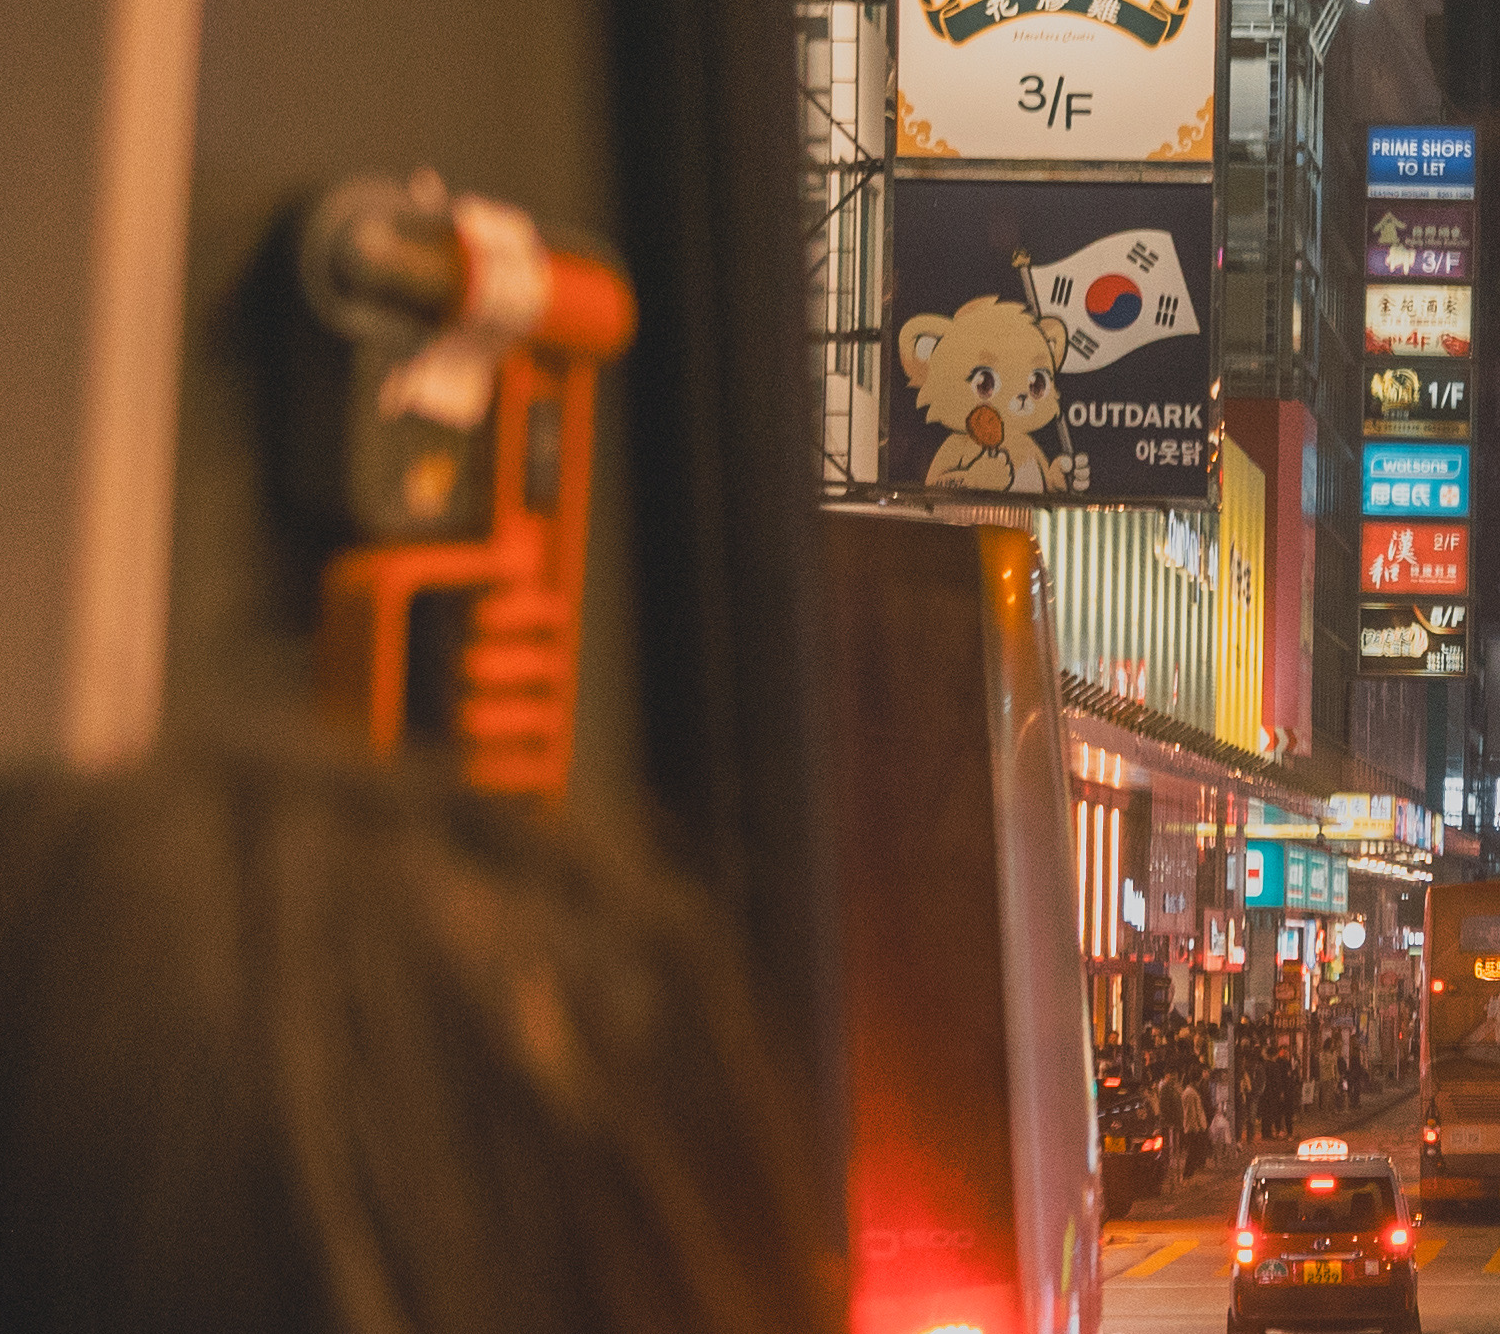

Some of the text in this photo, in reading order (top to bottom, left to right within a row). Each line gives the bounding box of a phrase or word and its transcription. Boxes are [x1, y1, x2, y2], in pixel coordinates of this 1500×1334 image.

[1017, 74, 1093, 130] 3/F
[1372, 139, 1472, 158] PRIME SHOPS
[1397, 159, 1446, 176] TO LET
[1421, 250, 1461, 274] 3/F
[1428, 380, 1465, 410] 1/F
[1068, 401, 1203, 428] OUTDARK
[1136, 440, 1203, 467] 아웃닭
[1433, 532, 1461, 552] 2/F
